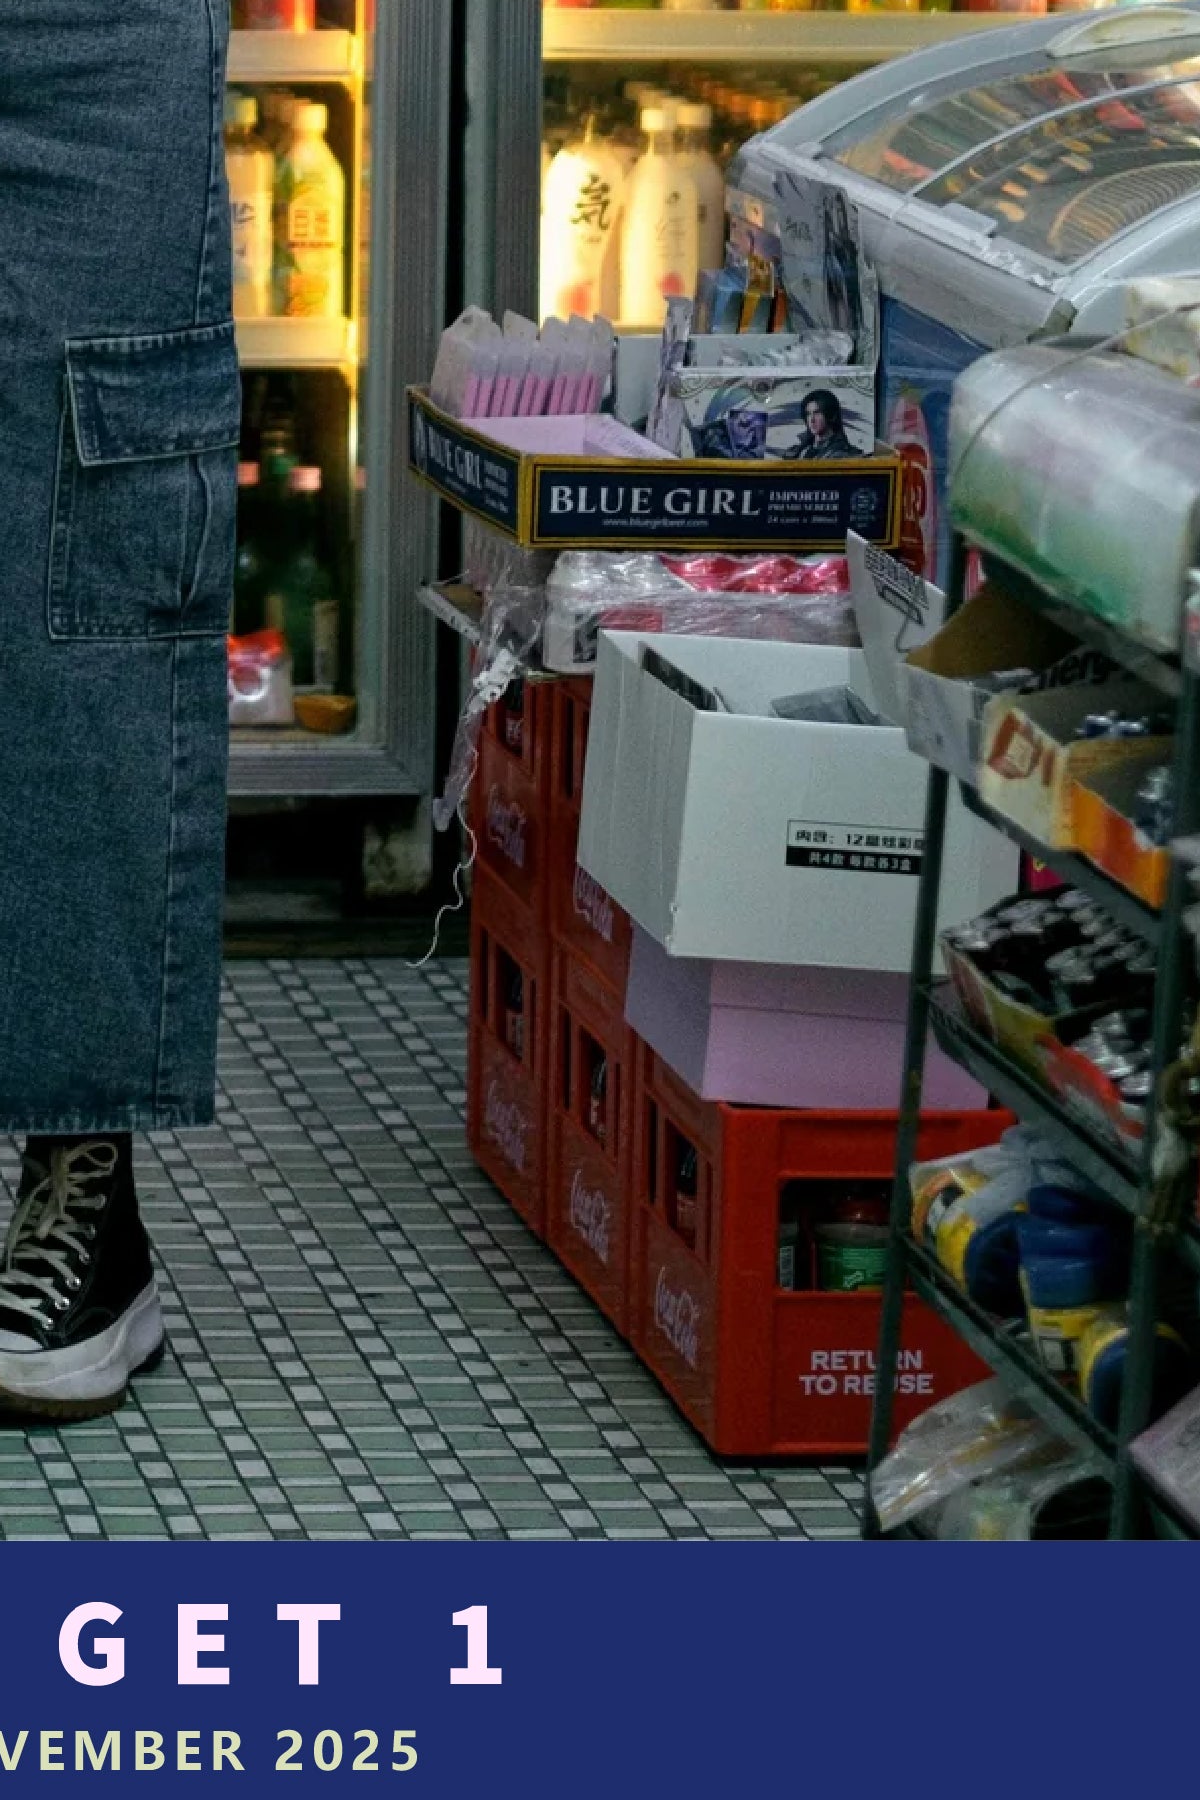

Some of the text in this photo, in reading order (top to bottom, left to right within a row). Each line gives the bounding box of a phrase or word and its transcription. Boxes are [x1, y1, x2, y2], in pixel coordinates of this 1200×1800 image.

[549, 485, 761, 516] BLUE GIRL
[769, 490, 840, 501] IMPORTED
[799, 1373, 936, 1396] TO RESE
